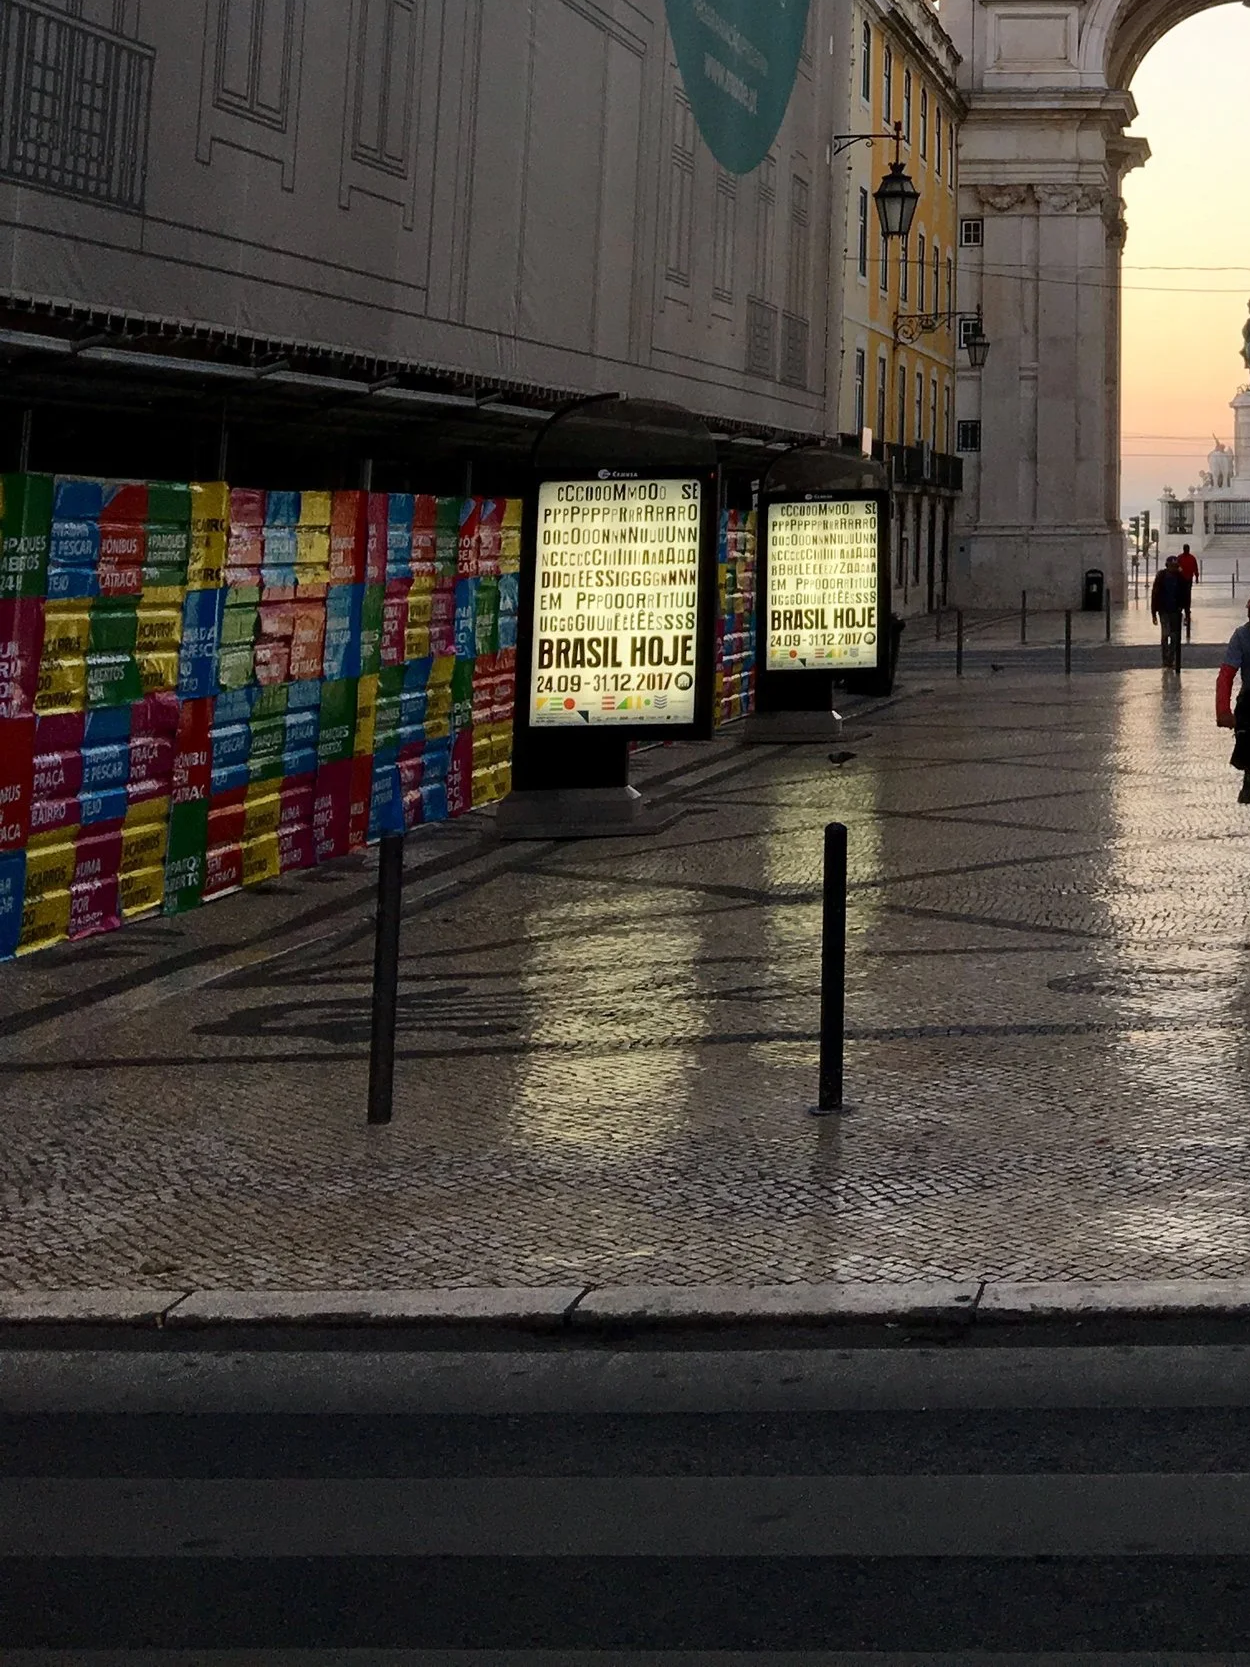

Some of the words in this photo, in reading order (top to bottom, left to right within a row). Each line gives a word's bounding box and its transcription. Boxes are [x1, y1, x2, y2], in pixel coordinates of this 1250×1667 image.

[681, 482, 699, 500] SE
[865, 502, 877, 515] SE
[101, 571, 138, 587] CATRACA
[771, 578, 787, 591] EM
[540, 592, 562, 610] EM
[771, 608, 828, 631] BRASIL
[834, 607, 877, 628] HOJE
[770, 634, 801, 647] 24.09
[809, 633, 862, 646] 31.12.2017
[538, 636, 622, 669] BRASIL
[630, 635, 694, 667] HOJE
[537, 675, 582, 693] 24.09
[593, 672, 673, 692] 31.12.2017
